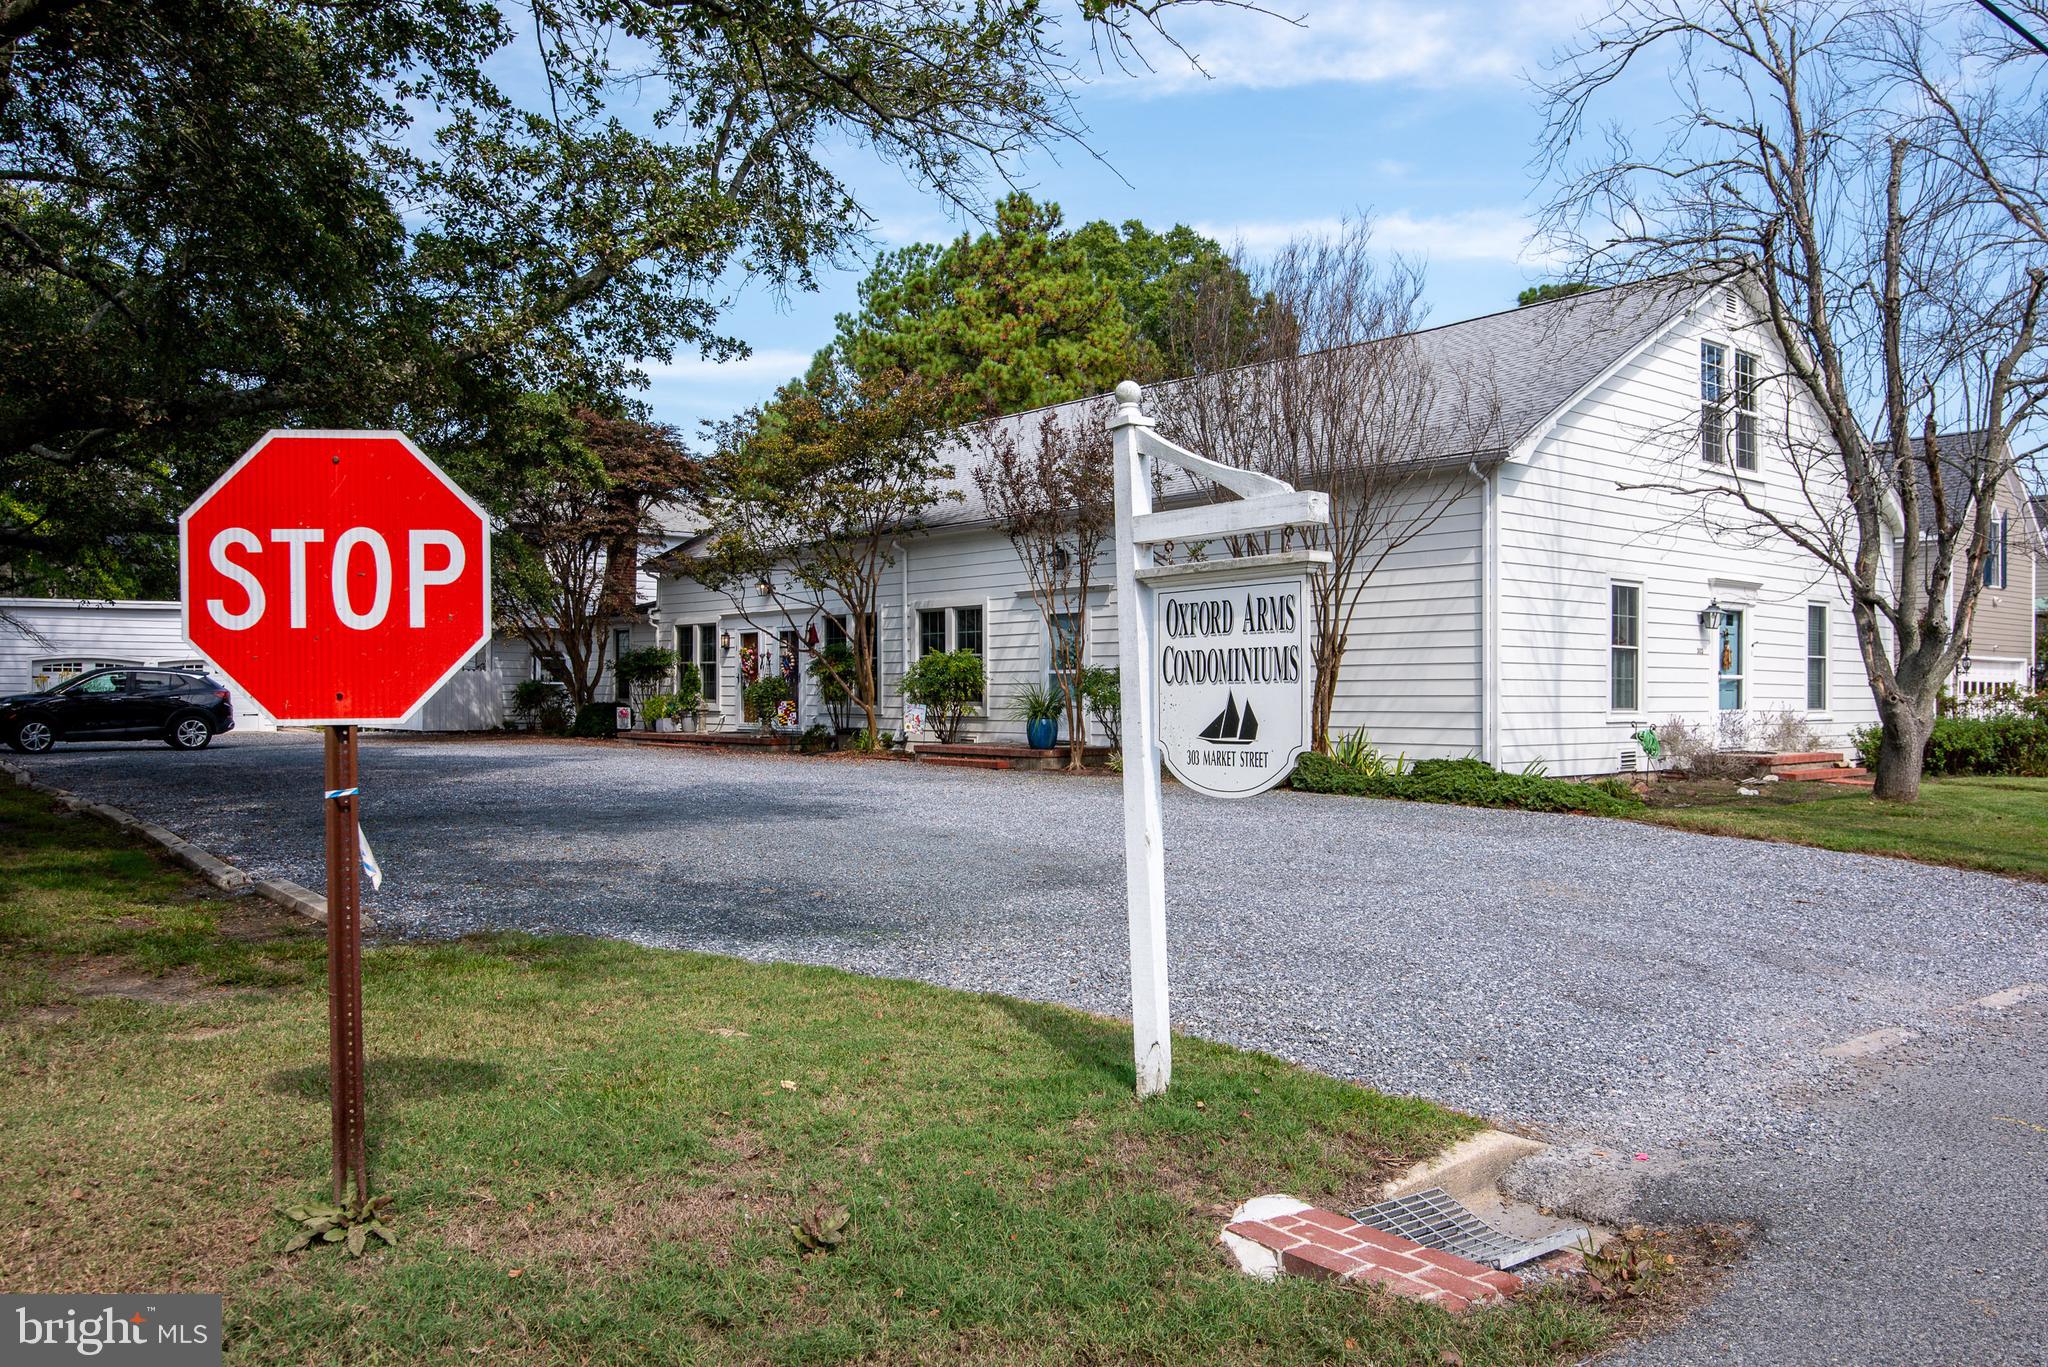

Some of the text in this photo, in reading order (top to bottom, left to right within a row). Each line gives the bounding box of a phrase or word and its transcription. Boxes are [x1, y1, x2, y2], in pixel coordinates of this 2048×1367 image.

[206, 526, 466, 631] STOP
[1166, 592, 1296, 639] OXFORD ARMS
[1162, 644, 1300, 686] CONDOMINIUMS
[1186, 749, 1269, 768] 303 MARKET STREET
